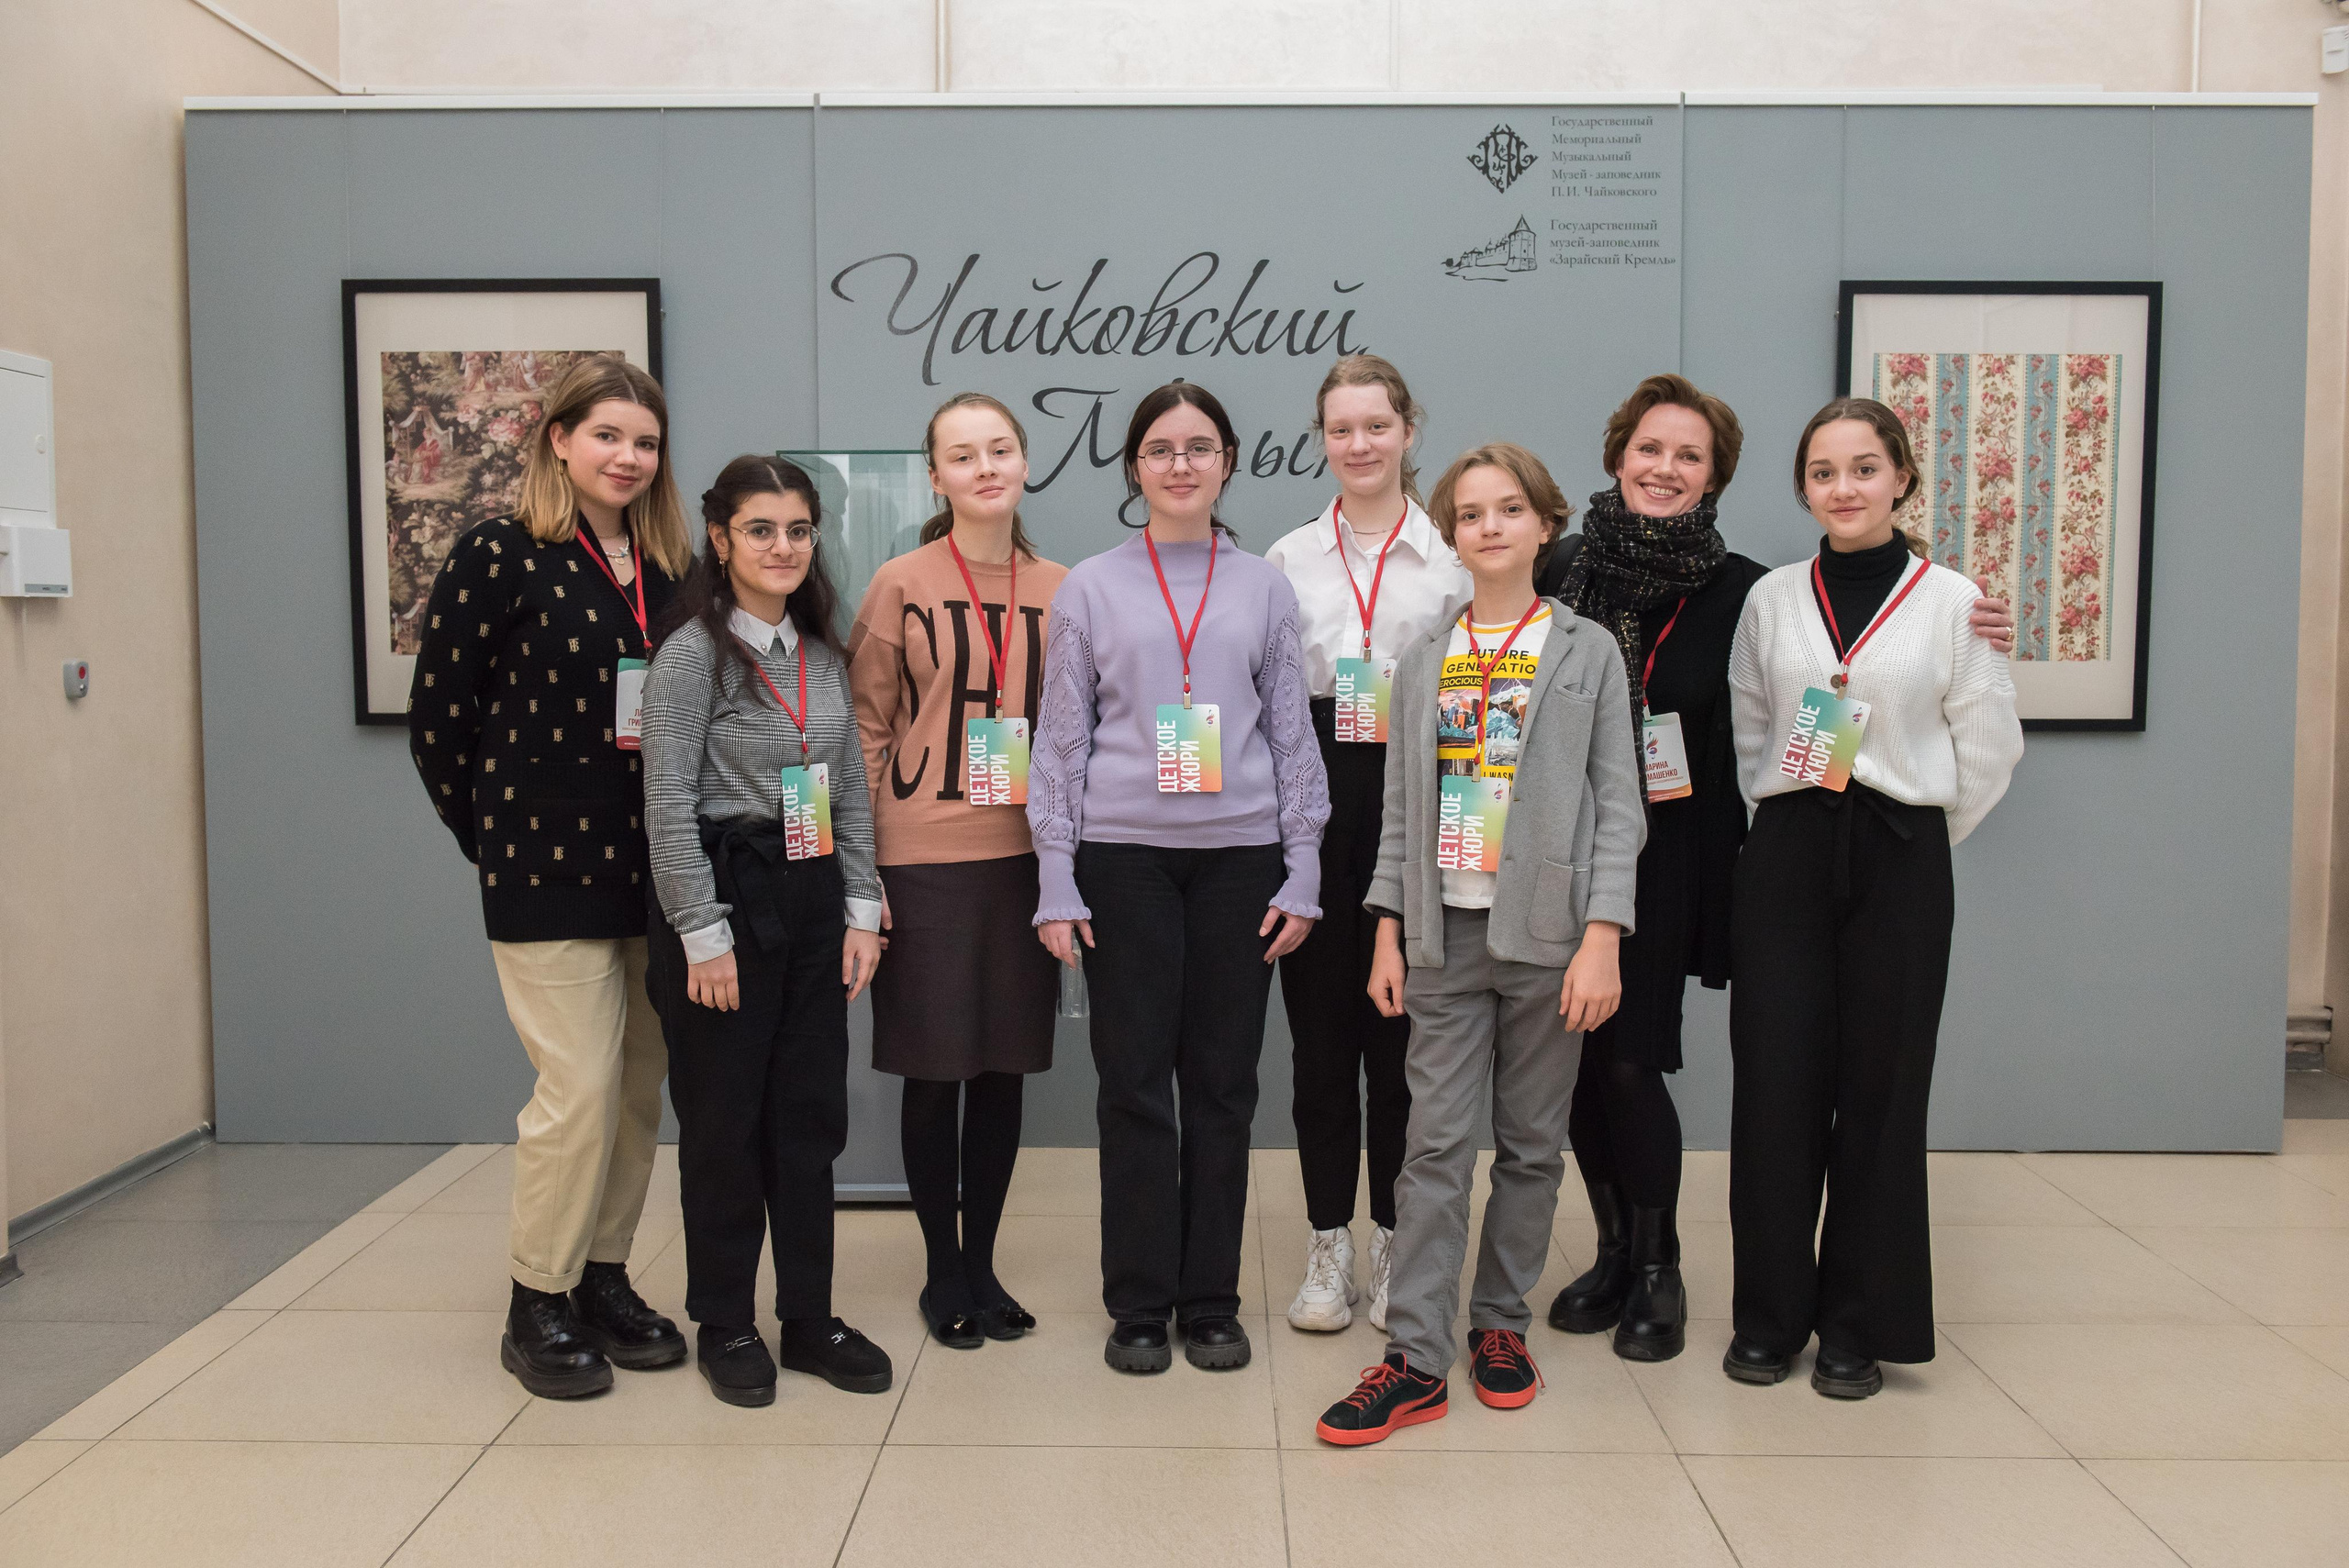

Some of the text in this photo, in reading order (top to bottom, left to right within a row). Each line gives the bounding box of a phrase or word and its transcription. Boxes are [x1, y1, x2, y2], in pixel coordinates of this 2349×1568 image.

[1552, 116, 1653, 129] Государственный
[1552, 133, 1642, 147] Мемориальный
[1552, 150, 1631, 164] Музыкальный
[1585, 186, 1657, 197] Чайковского
[1550, 219, 1657, 234] Государственный
[1550, 237, 1660, 250] музей-заповедник
[1335, 673, 1356, 742] ДЕТСКОЕ
[1357, 693, 1376, 742] ЖЮРИ
[1156, 720, 1180, 792] ДЕТСКОЕ
[1179, 740, 1201, 792] ЖЮРИ
[1778, 702, 1820, 780] ДЕТСКОЕ
[1800, 729, 1838, 786] ЖЮРИ
[968, 734, 992, 806] ДЕТСКОЕ
[990, 753, 1012, 805] ЖЮРИ
[782, 783, 804, 861] ДЕТСКОЕ
[801, 803, 820, 859] ЖЮРИ
[1437, 792, 1462, 871] ДЕТСКОЕ
[1461, 816, 1485, 872] ЖЮРИ
